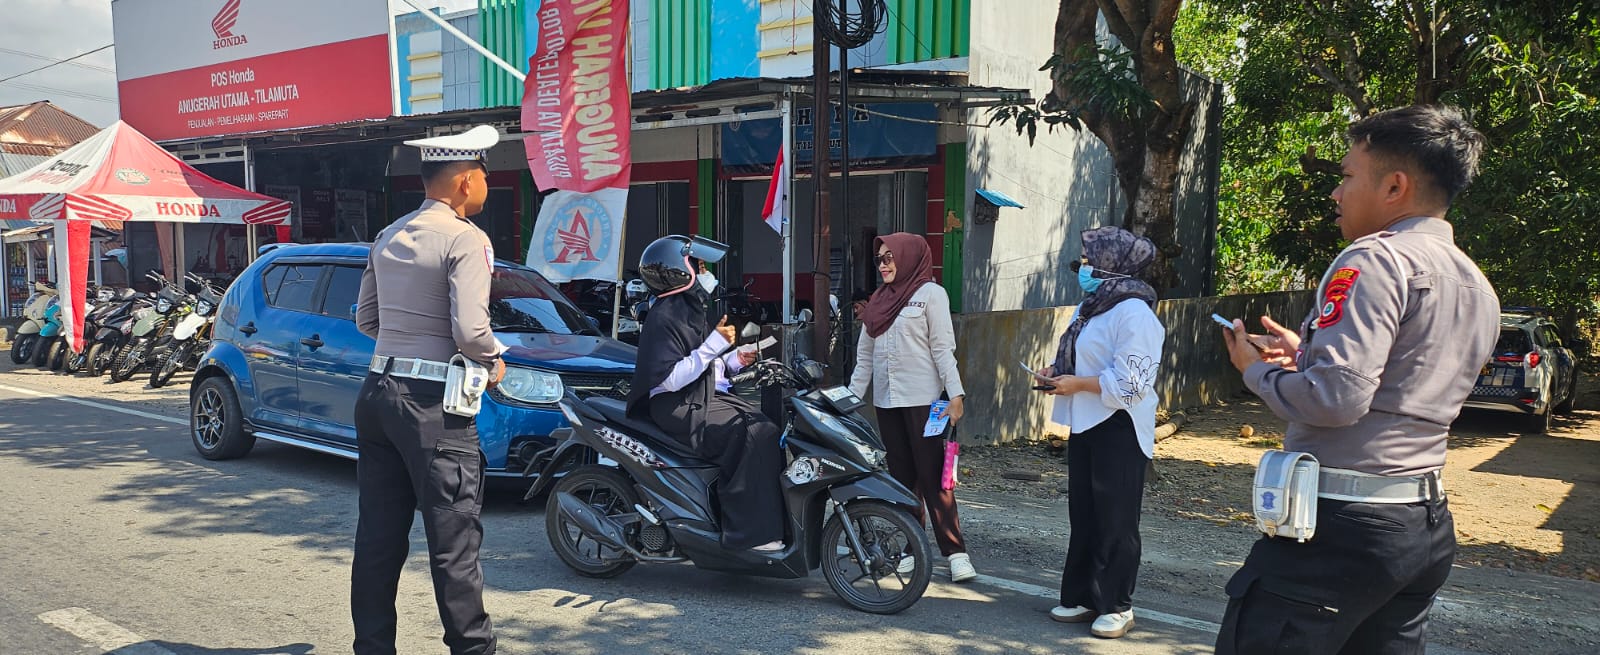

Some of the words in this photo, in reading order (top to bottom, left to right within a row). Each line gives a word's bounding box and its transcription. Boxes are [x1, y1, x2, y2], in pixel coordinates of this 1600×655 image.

[213, 35, 248, 49] HONDA
[211, 70, 227, 87] POS
[229, 67, 255, 84] Honda
[178, 97, 220, 114] ANUGERAH
[221, 92, 250, 109] UTAMA
[254, 84, 299, 104] TILAMUTA
[188, 118, 215, 129] PENJUALAN
[217, 113, 255, 126] PEMELIHARAAN
[258, 109, 289, 121] SPAREPART
[156, 202, 221, 218] HONDA
[821, 457, 846, 471] HONDA
